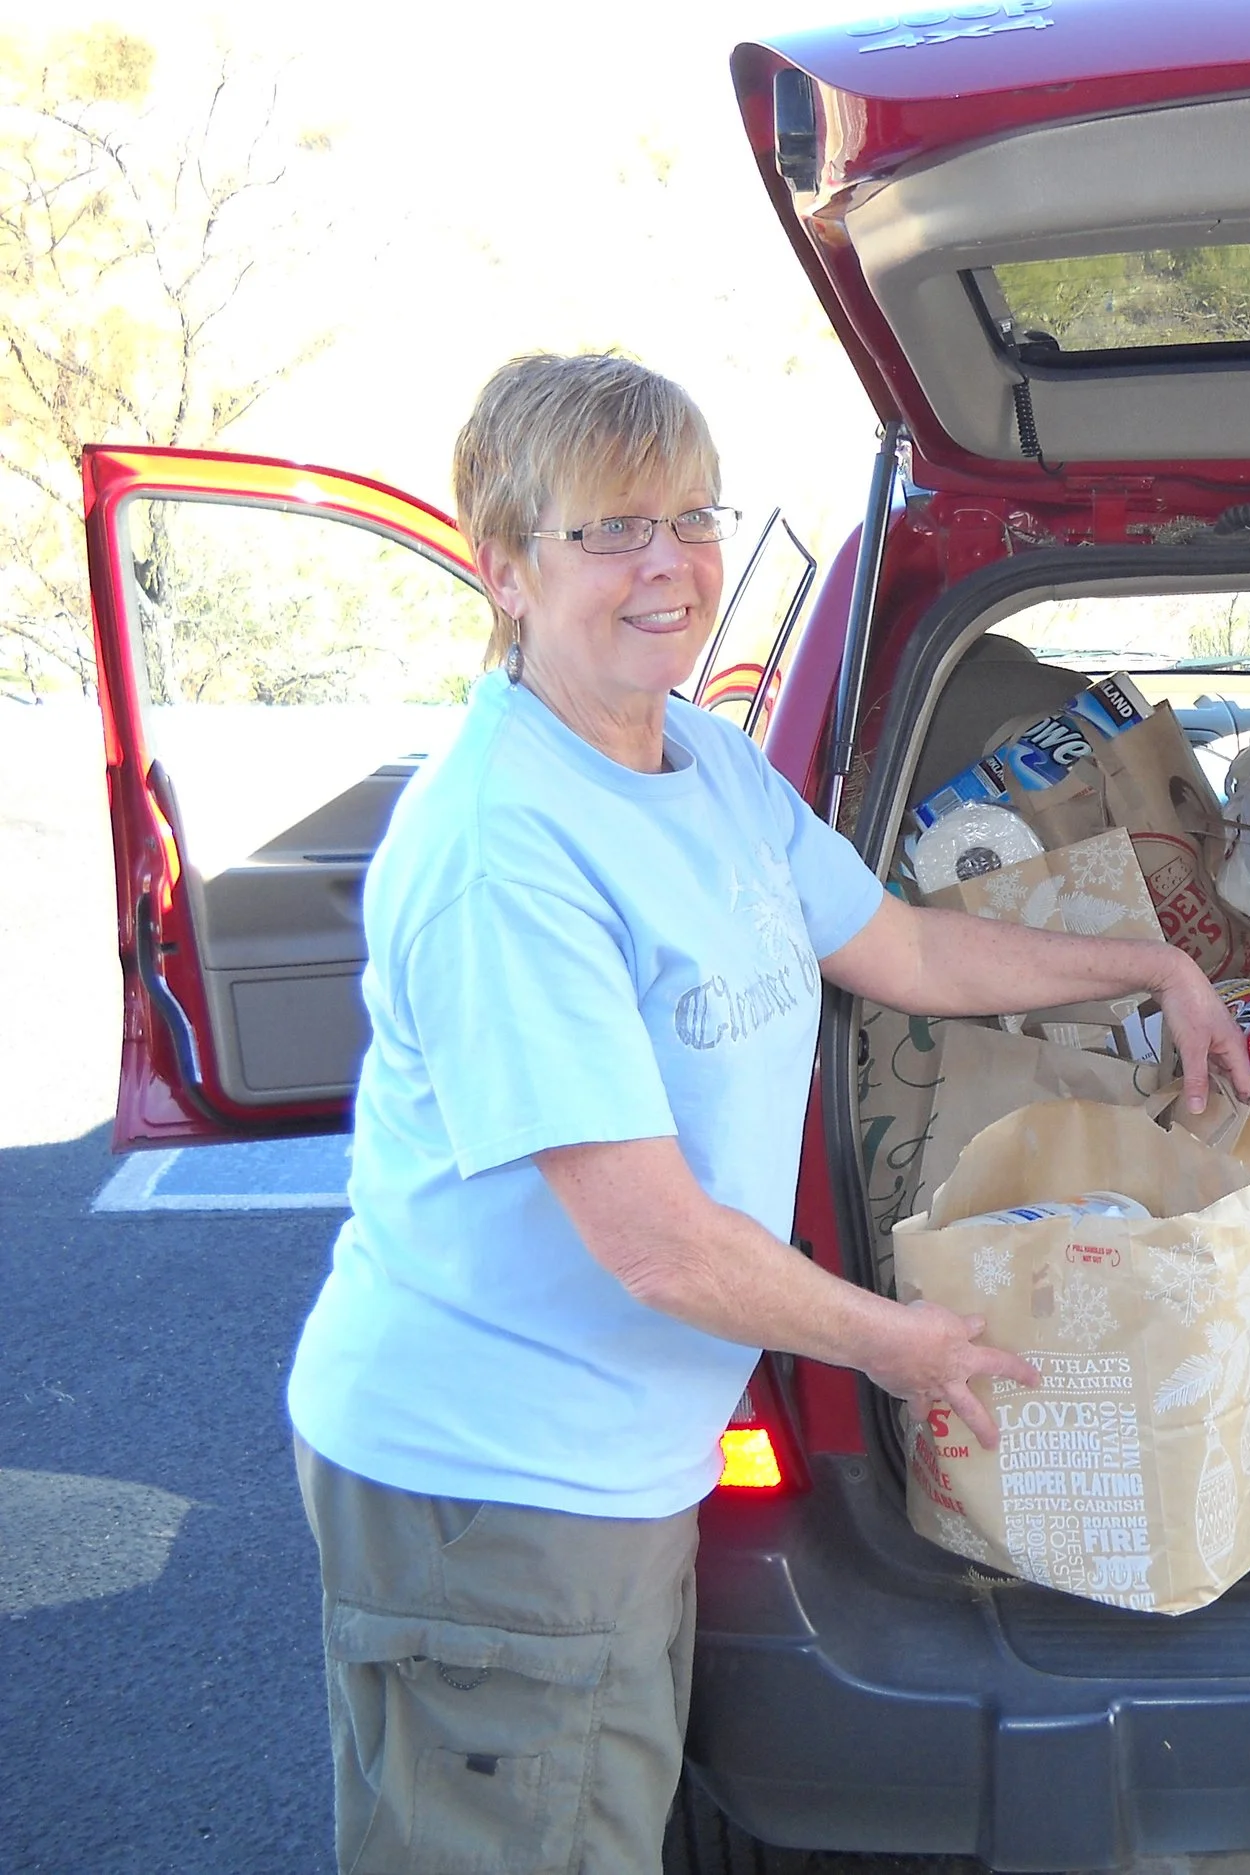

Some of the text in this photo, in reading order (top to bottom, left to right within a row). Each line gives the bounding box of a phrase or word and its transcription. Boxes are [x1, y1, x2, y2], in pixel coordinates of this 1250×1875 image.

[1050, 1357, 1131, 1374] THAT'S
[992, 1375, 1133, 1395] ENRTAINING
[996, 1401, 1100, 1431] LOVE
[1100, 1401, 1120, 1469] PIANO
[1119, 1402, 1142, 1470] MUSIC
[999, 1430, 1100, 1454] FLICKERING
[1000, 1451, 1101, 1471] CANDLELIGHT
[1001, 1471, 1144, 1497] PROPER PLATING
[1002, 1498, 1146, 1513] FESTIVE GARNISH
[1082, 1515, 1148, 1529] ROARING
[1083, 1528, 1151, 1554] FIRE
[1086, 1555, 1153, 1592] JOY
